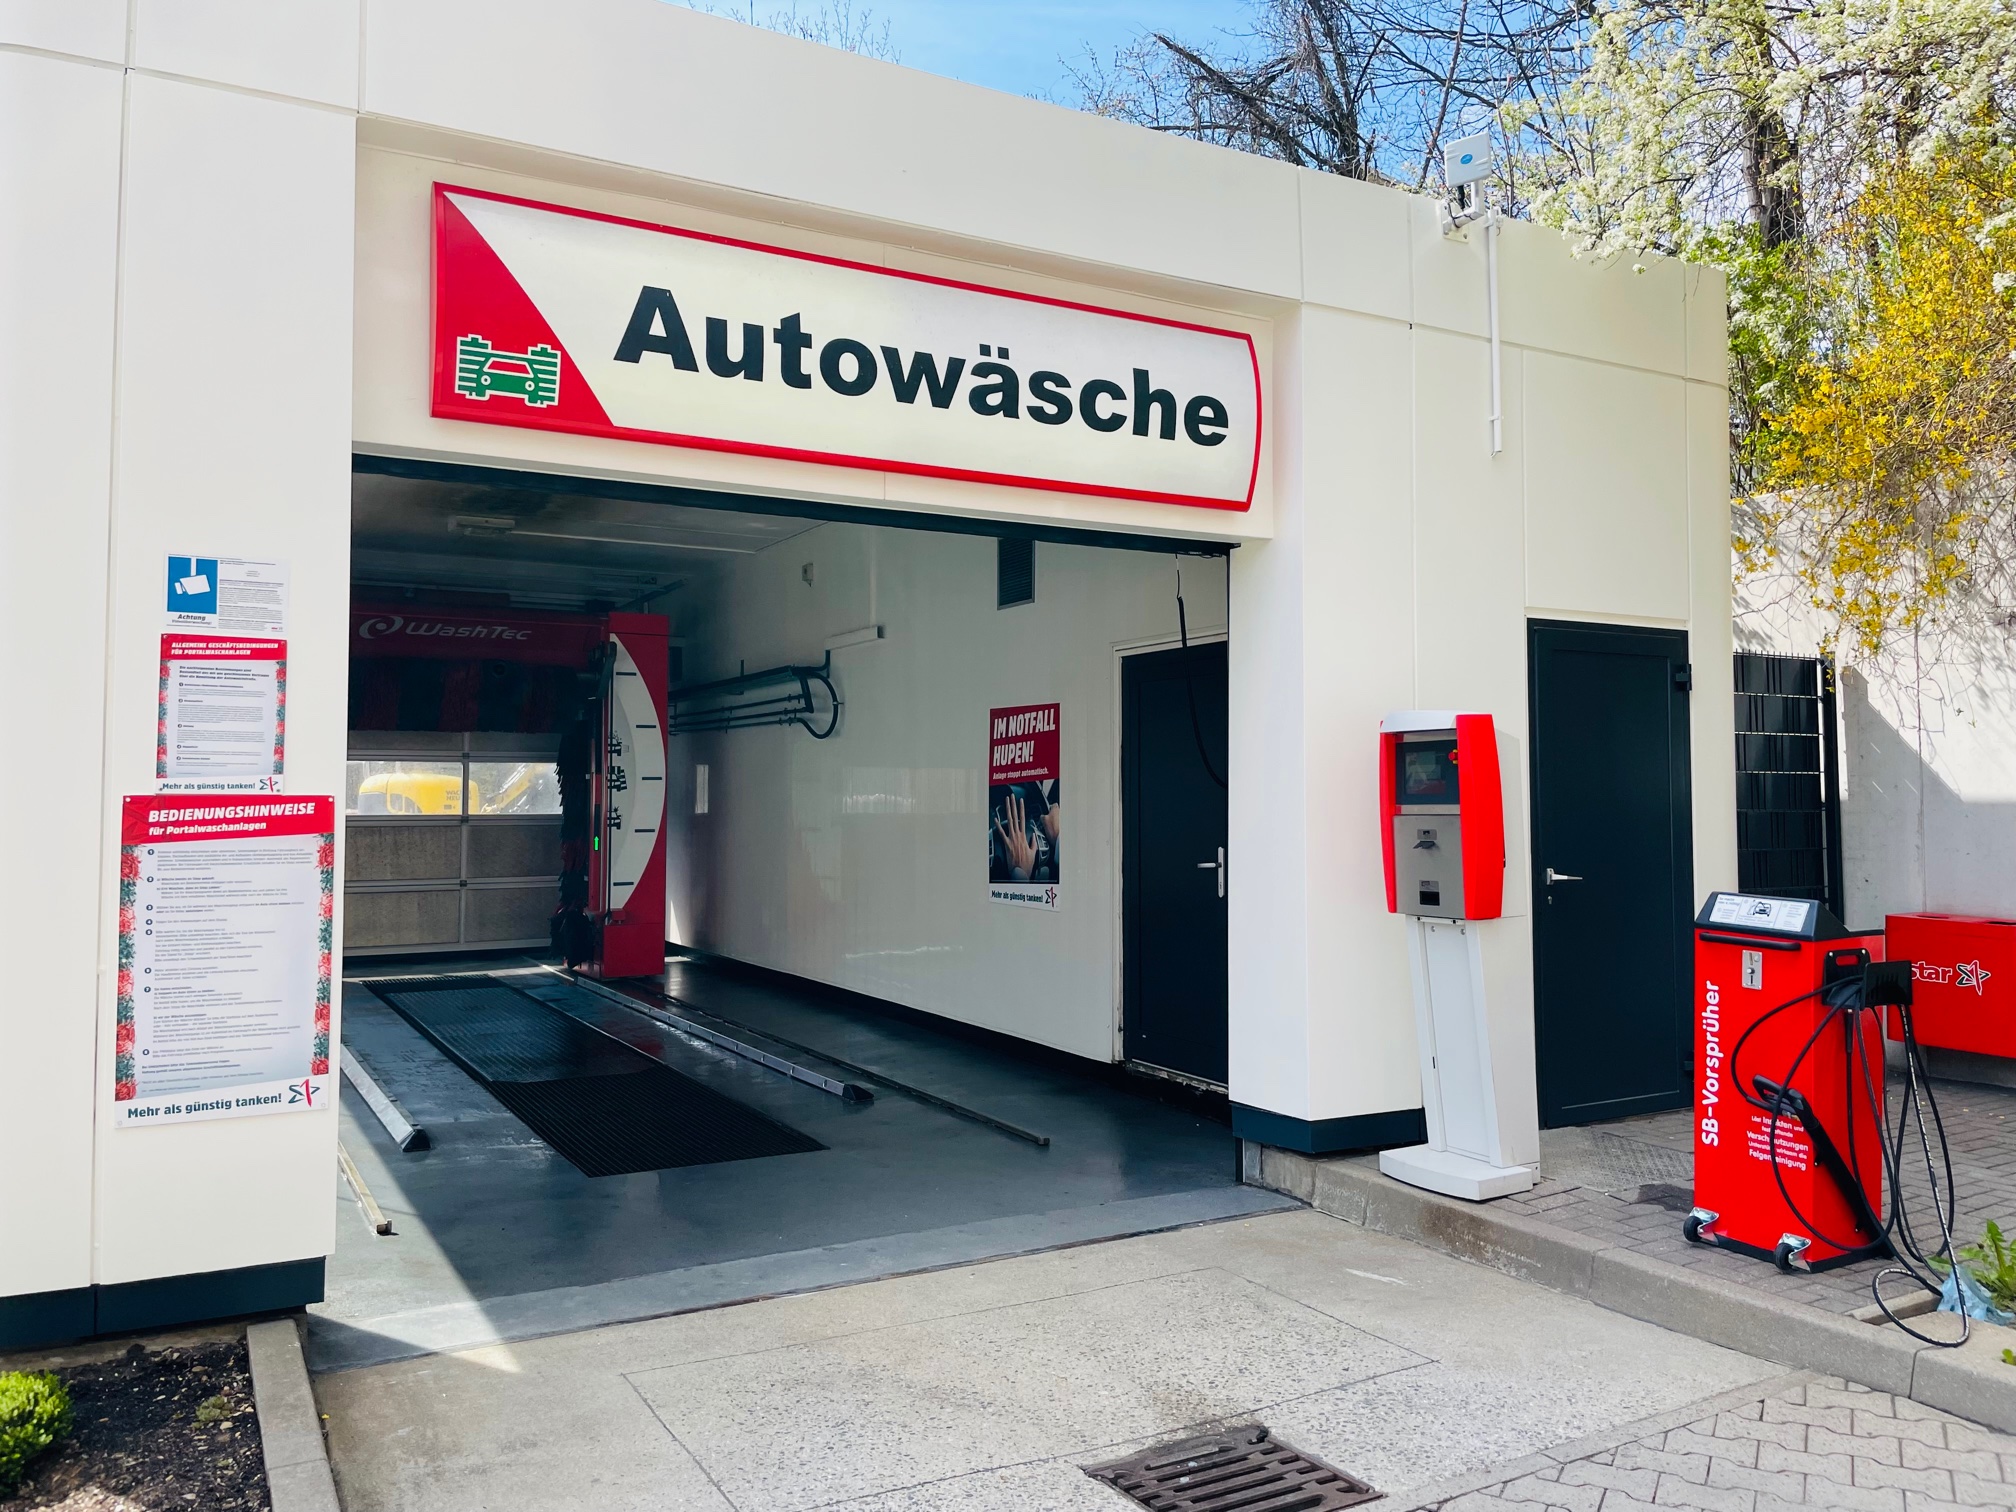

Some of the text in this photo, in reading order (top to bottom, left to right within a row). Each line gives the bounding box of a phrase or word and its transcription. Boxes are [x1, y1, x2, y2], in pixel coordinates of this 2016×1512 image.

[613, 285, 1229, 447] Autowäsche
[177, 613, 206, 621] Achtung
[404, 621, 533, 641] WashTec
[993, 708, 1056, 740] IM NOTFALL
[992, 740, 1035, 767] HUPEN!
[162, 782, 256, 792] Mehr als günstig tanken!
[148, 802, 316, 823] BEDIENUNGSHINWEISE
[148, 821, 267, 836] für Portalwaschanlagen
[1701, 980, 1724, 1147] SB-Vorsprüher
[127, 1092, 282, 1119] Mehr als günstig tanken!
[1748, 1148, 1807, 1171] Felgeneinigung
